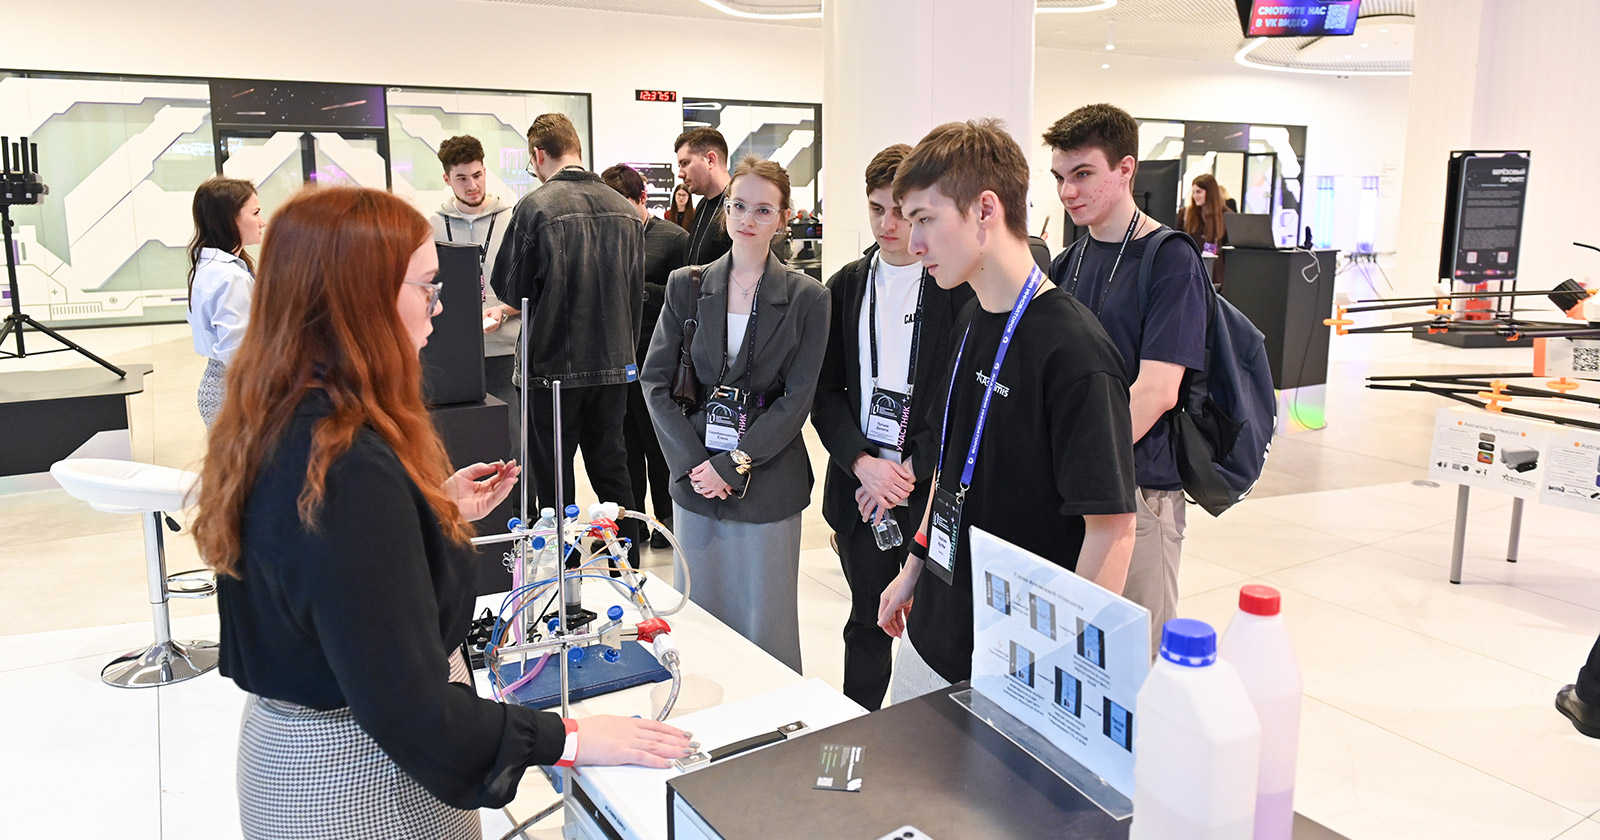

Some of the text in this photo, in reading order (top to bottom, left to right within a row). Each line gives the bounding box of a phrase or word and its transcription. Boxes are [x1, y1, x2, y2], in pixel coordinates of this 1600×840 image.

[1258, 5, 1327, 15] СМОТРИТЕ НАС
[1255, 18, 1263, 27] В
[640, 90, 676, 101] 12:37:57
[896, 405, 911, 451] УЧАСТНИК
[948, 523, 958, 573] РЕЗИДЕНТ
